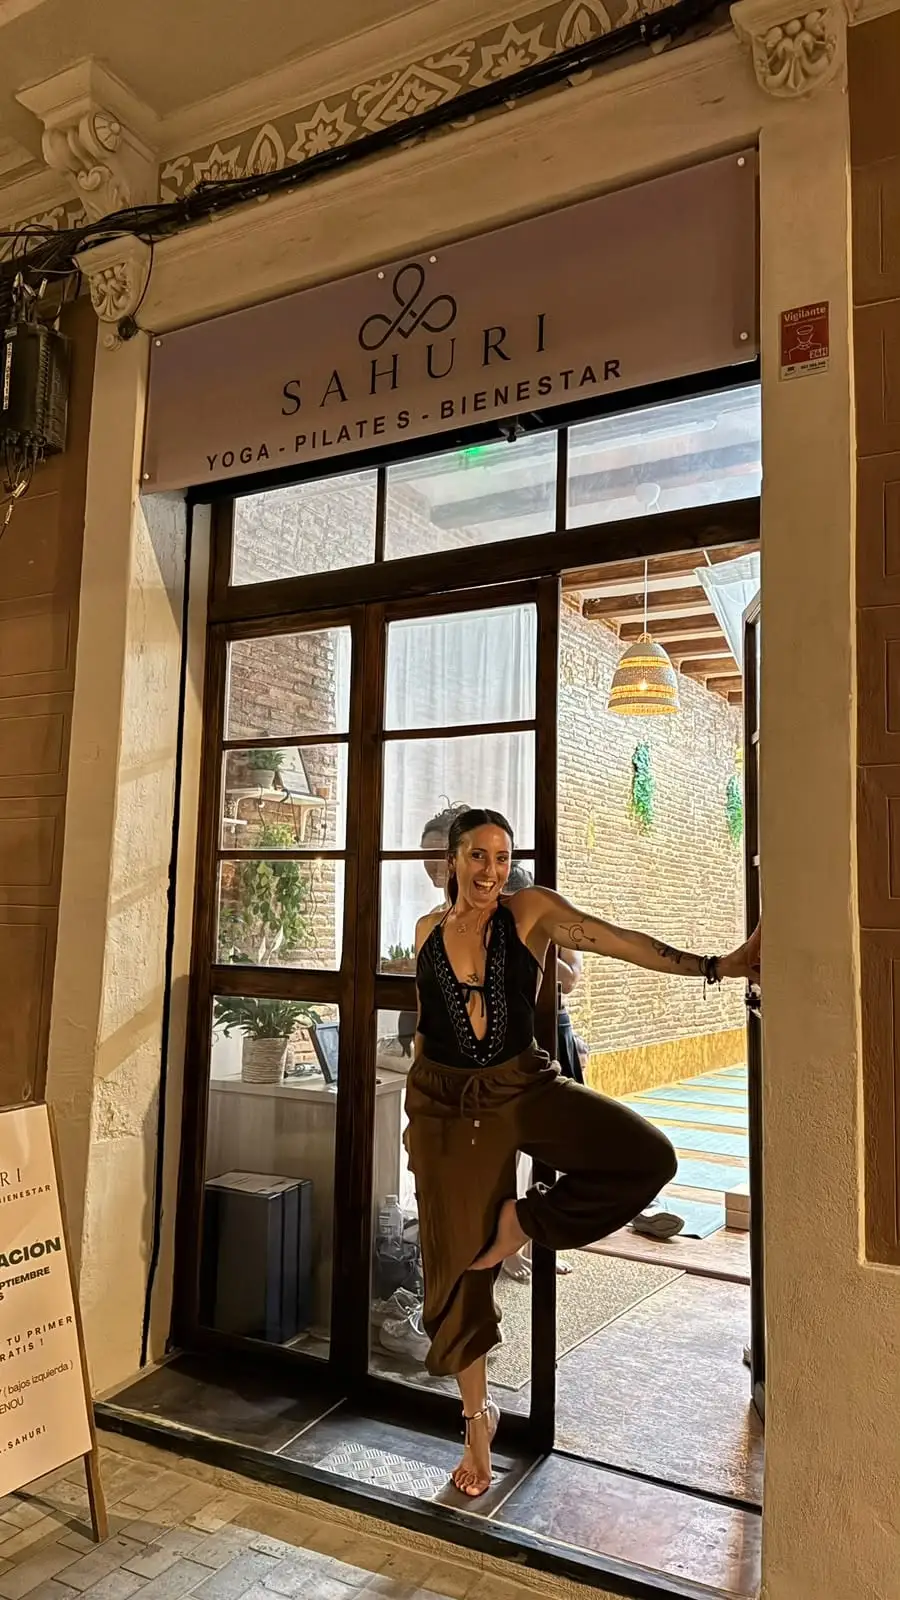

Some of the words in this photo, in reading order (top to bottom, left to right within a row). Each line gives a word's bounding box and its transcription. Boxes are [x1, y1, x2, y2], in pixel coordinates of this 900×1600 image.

[783, 306, 827, 323] Vigilante
[281, 313, 546, 417] SAHURI
[206, 443, 270, 471] YOGA
[295, 410, 410, 453] PILATES
[440, 359, 621, 420] BIENESTAR
[6, 1334, 21, 1346] TU
[27, 1315, 73, 1339] PRIMER
